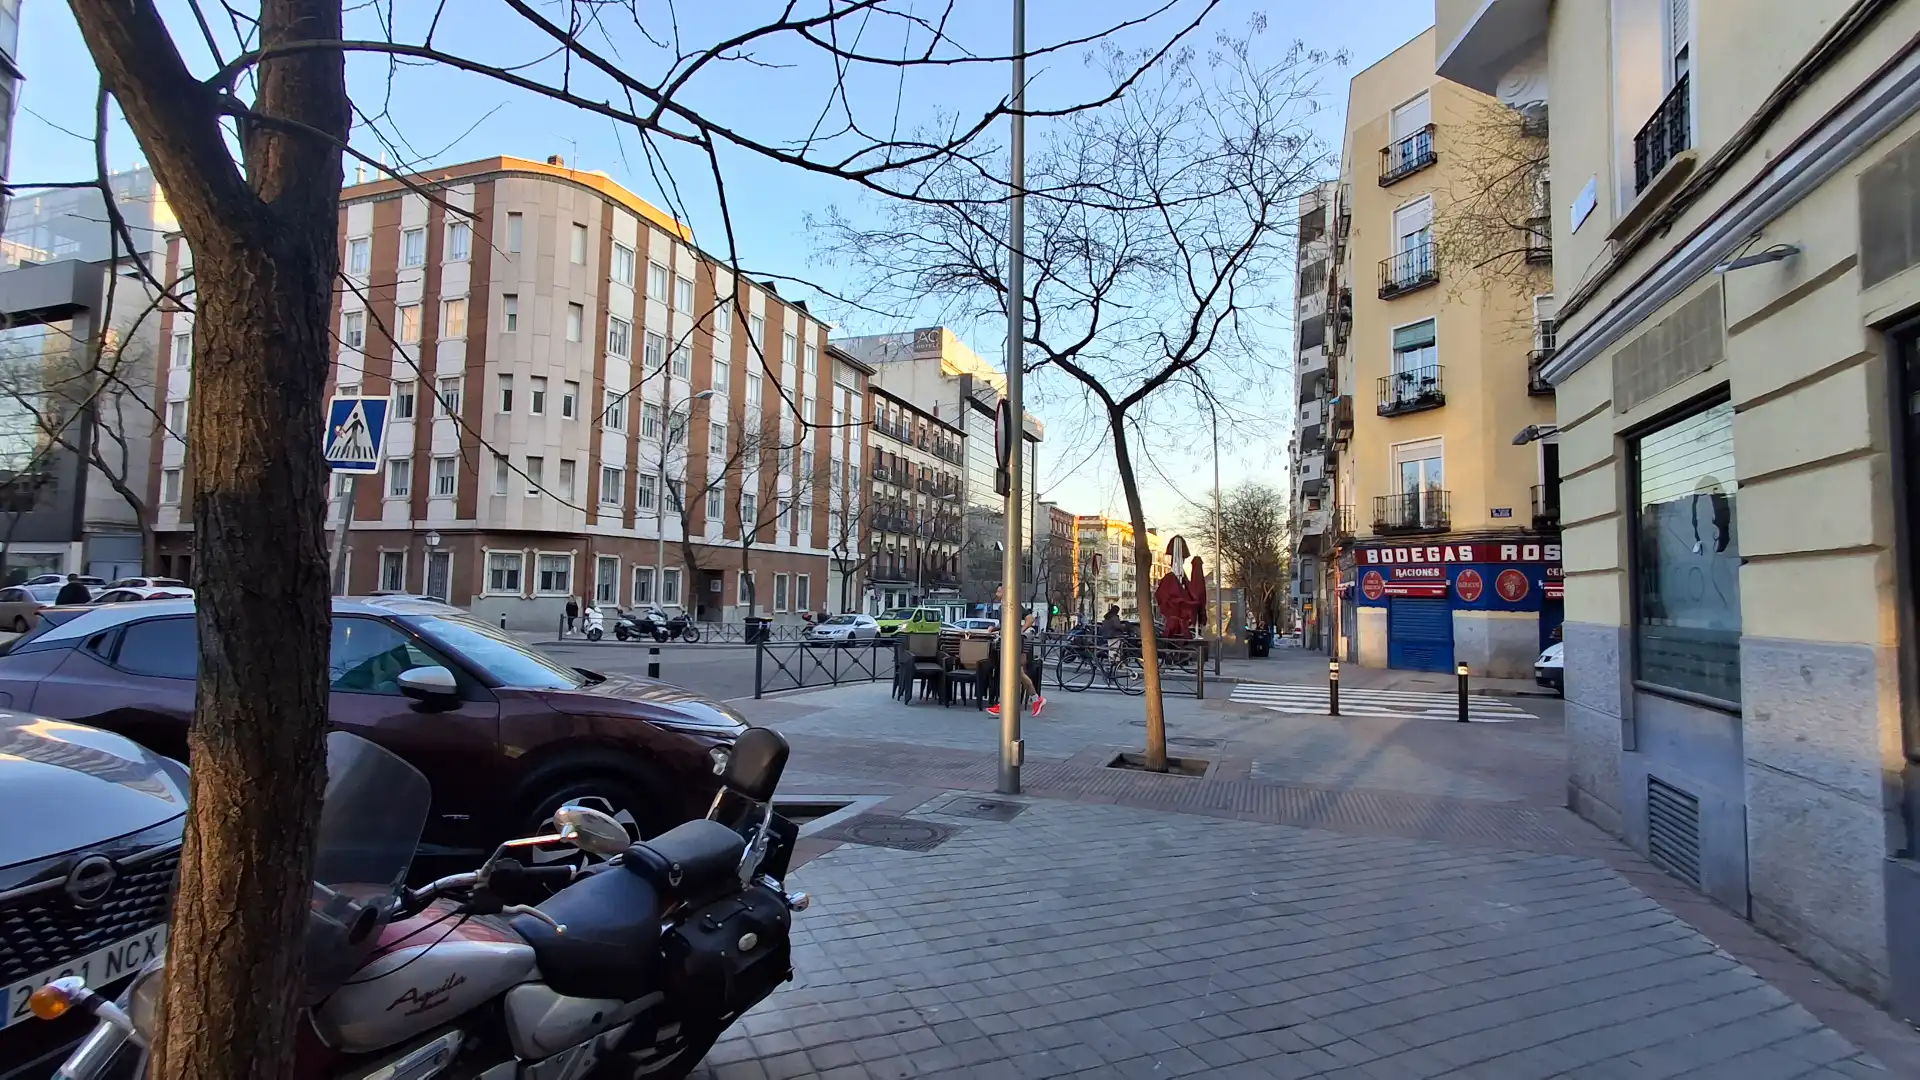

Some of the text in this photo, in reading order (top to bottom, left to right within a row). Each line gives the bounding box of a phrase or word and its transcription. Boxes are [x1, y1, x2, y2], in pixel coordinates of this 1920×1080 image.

[1366, 545, 1473, 563] BODEGAS
[1395, 568, 1440, 577] RACIONES
[12, 931, 159, 1019] 21 NCX
[385, 971, 468, 1011] Aquila
